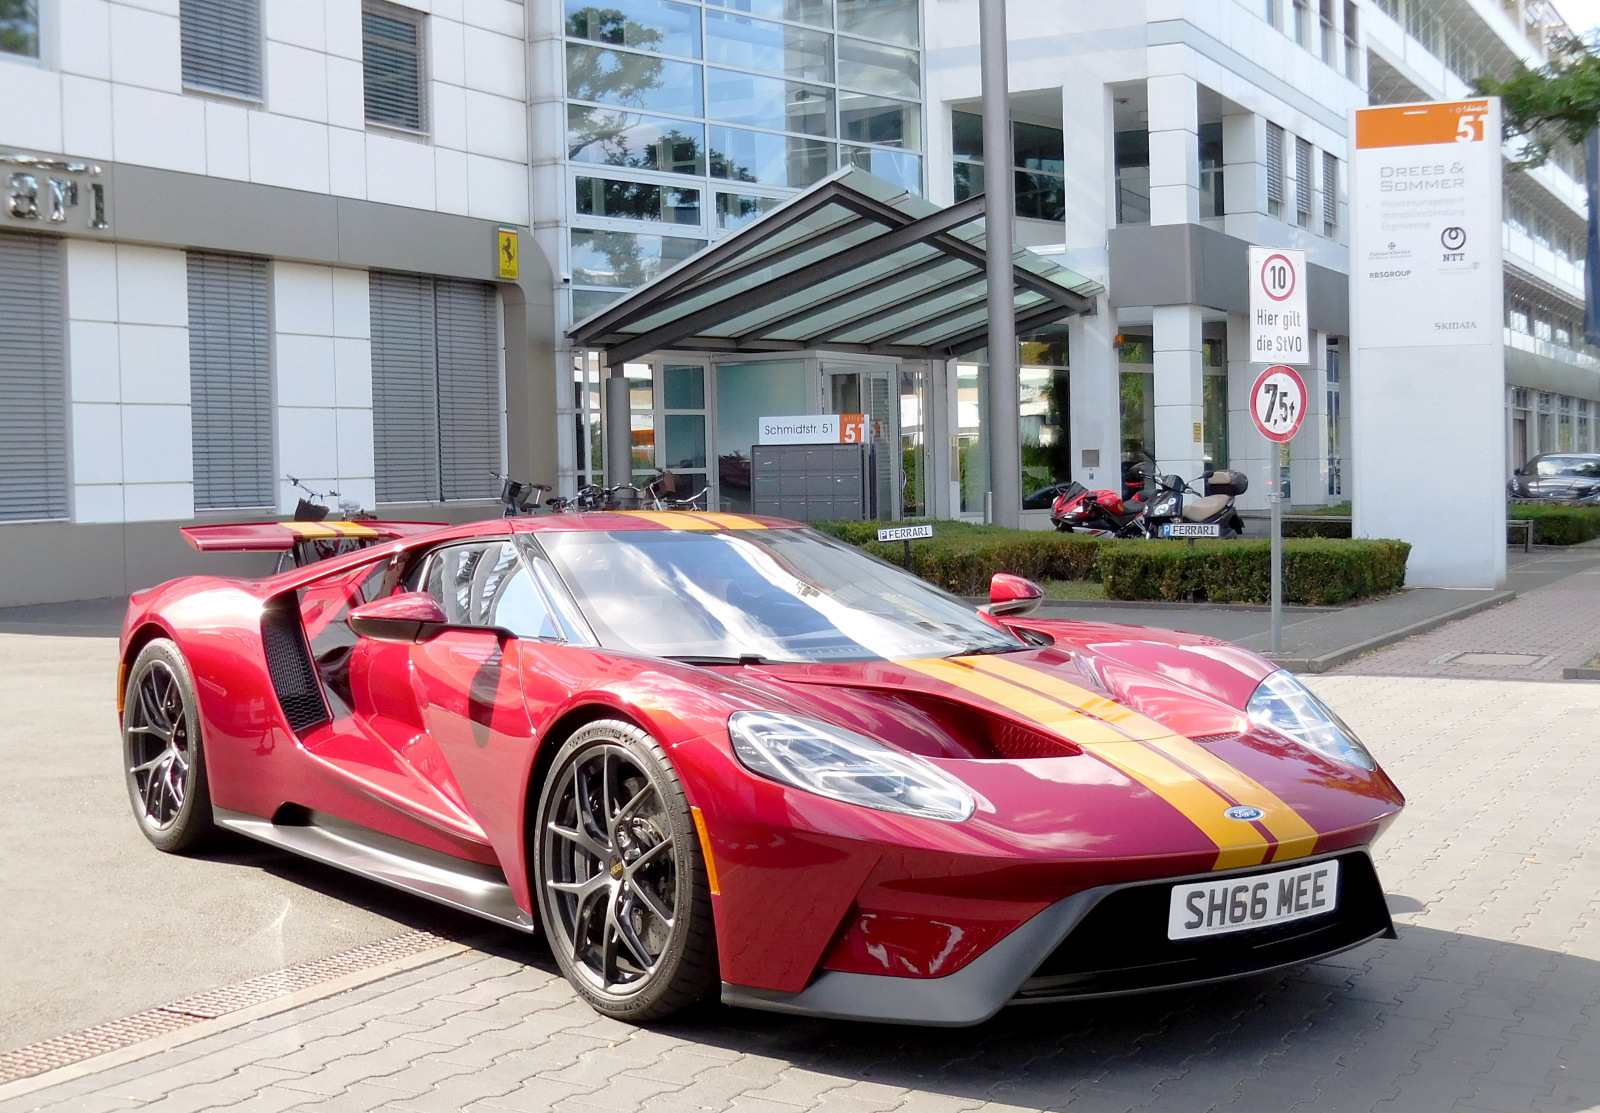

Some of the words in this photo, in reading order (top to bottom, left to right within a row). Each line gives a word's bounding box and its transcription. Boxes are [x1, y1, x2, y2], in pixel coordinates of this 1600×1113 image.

[1455, 114, 1488, 143] 51
[1380, 165, 1445, 178] DREES
[1449, 162, 1465, 174] &
[1380, 178, 1465, 192] SOMMER
[1443, 253, 1465, 262] NTT
[1270, 265, 1287, 290] 10
[1369, 270, 1411, 278] RBSGROUP
[1257, 309, 1279, 326] Hier
[1282, 311, 1301, 331] gilt
[1435, 322, 1477, 330] SKIDATA
[1256, 336, 1273, 351] die
[1276, 335, 1302, 353] StVO
[764, 424, 819, 436] Schmidtstr.
[822, 423, 833, 434] 51
[844, 423, 865, 444] 51
[888, 527, 929, 539] FERRARI
[1173, 525, 1214, 535] FERRARI
[1184, 881, 1269, 929] SH66
[1276, 868, 1328, 916] MEE
